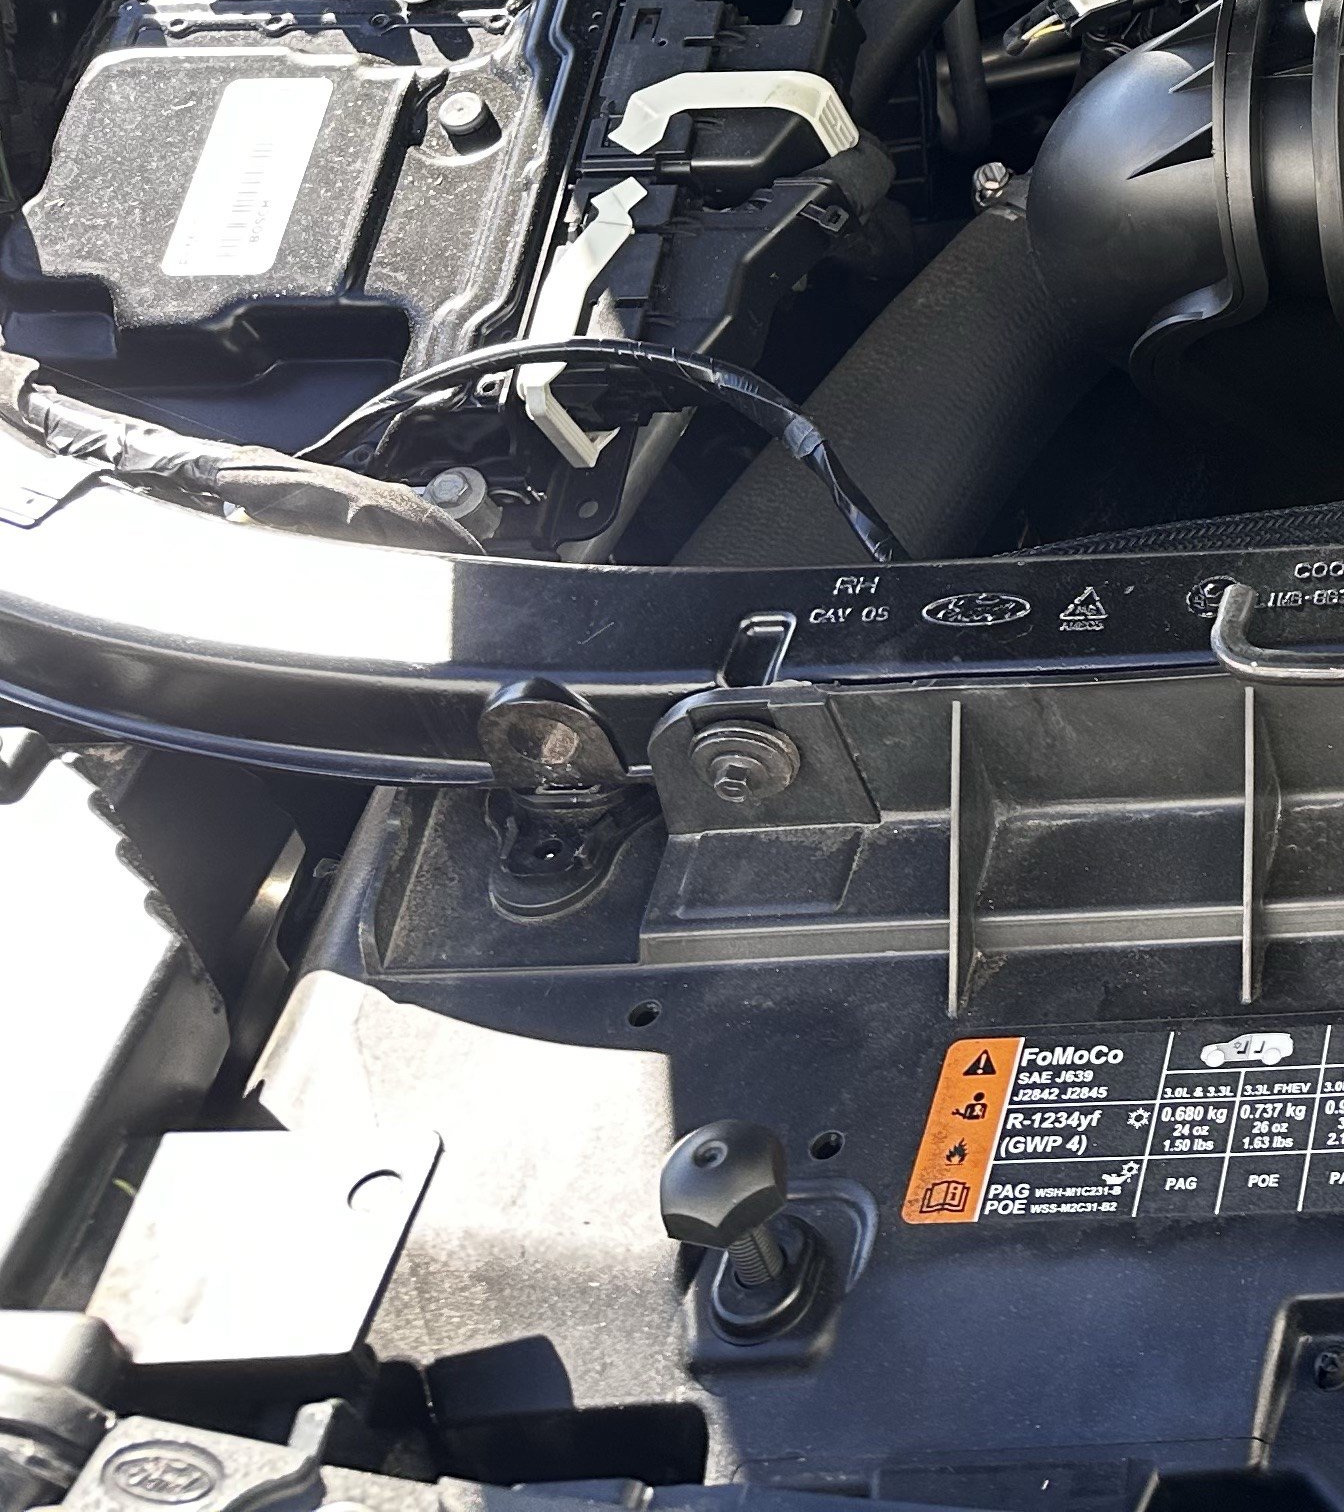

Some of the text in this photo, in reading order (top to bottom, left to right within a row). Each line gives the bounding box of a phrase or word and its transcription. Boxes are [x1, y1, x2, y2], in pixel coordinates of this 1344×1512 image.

[249, 199, 270, 243] BOSCH
[833, 576, 880, 595] RH
[1021, 1045, 1124, 1066] FoMoCo
[1017, 1070, 1093, 1085] SAE J639
[1012, 1087, 1108, 1101] J2842 J2845
[1164, 1086, 1234, 1099] 3.0L & 3.3L
[1243, 1082, 1311, 1096] 3.3L FHEV
[1161, 1105, 1228, 1123] 0.680 kg
[1240, 1103, 1306, 1120] 0.737 kg
[1006, 1110, 1103, 1131] R-1234yf
[1251, 1121, 1289, 1134] 26 oz
[1172, 1124, 1210, 1137] 24 oz
[999, 1134, 1087, 1157] (GWP 4)
[1163, 1138, 1214, 1151] 1.50 lbs
[1242, 1136, 1294, 1149] 1.63 lbs
[1164, 1177, 1198, 1191] PAG
[1247, 1174, 1280, 1188] POE
[988, 1184, 1122, 1199] PAG WSH-M1C231-B
[984, 1200, 1027, 1215] POE
